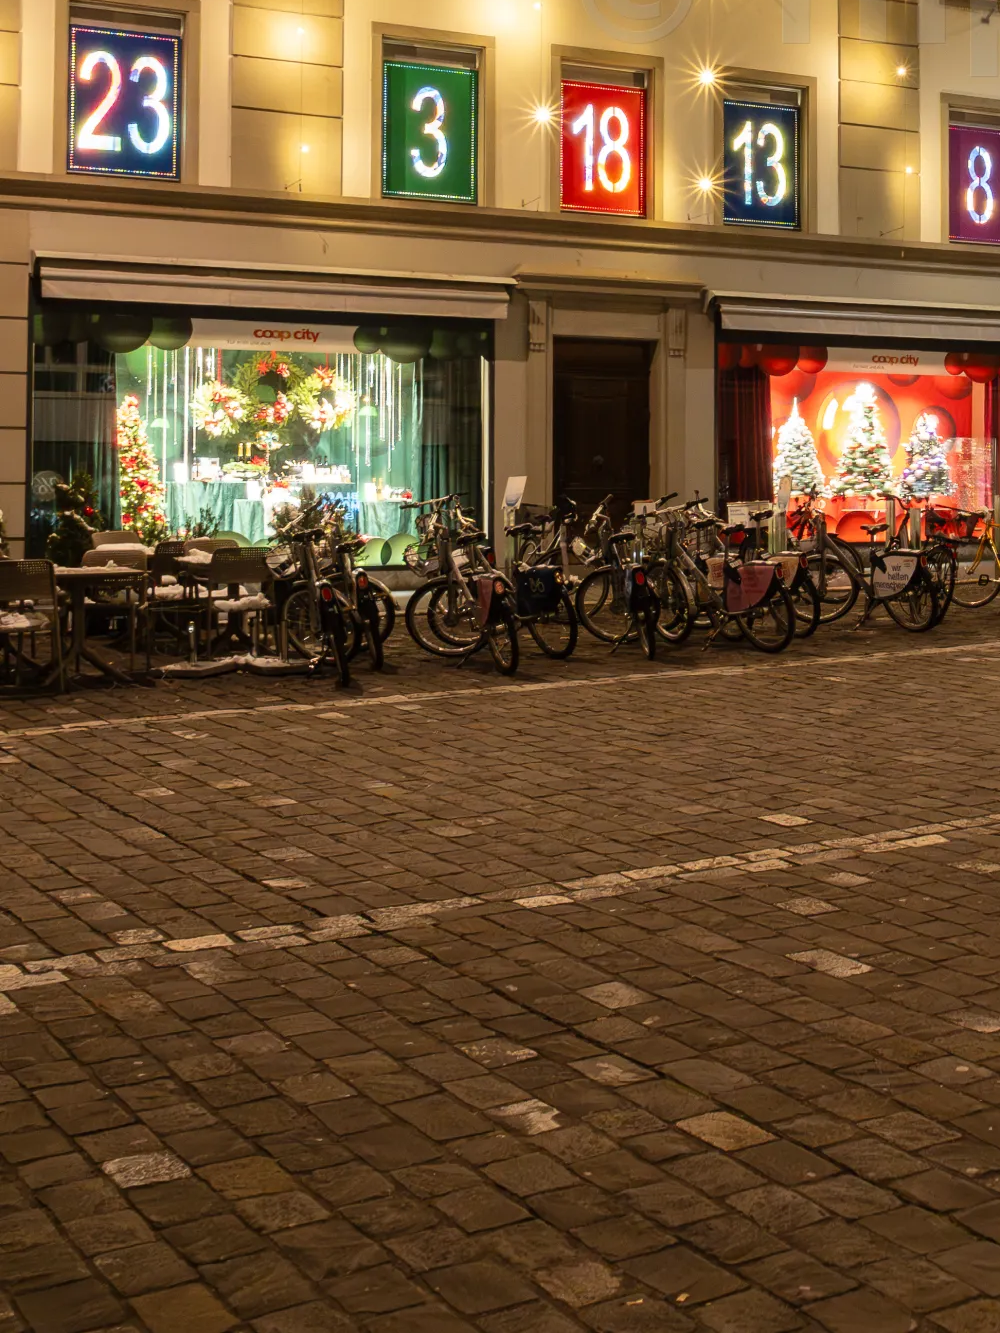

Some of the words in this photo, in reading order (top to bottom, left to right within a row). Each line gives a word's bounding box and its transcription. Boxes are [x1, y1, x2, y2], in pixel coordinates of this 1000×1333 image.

[77, 49, 171, 156] 23
[410, 87, 448, 178] 3
[571, 104, 631, 194] 18
[731, 121, 790, 206] 13
[963, 146, 998, 225] 8
[253, 328, 291, 342] coop
[293, 328, 320, 343] city
[872, 355, 899, 365] coop
[900, 354, 920, 366] city
